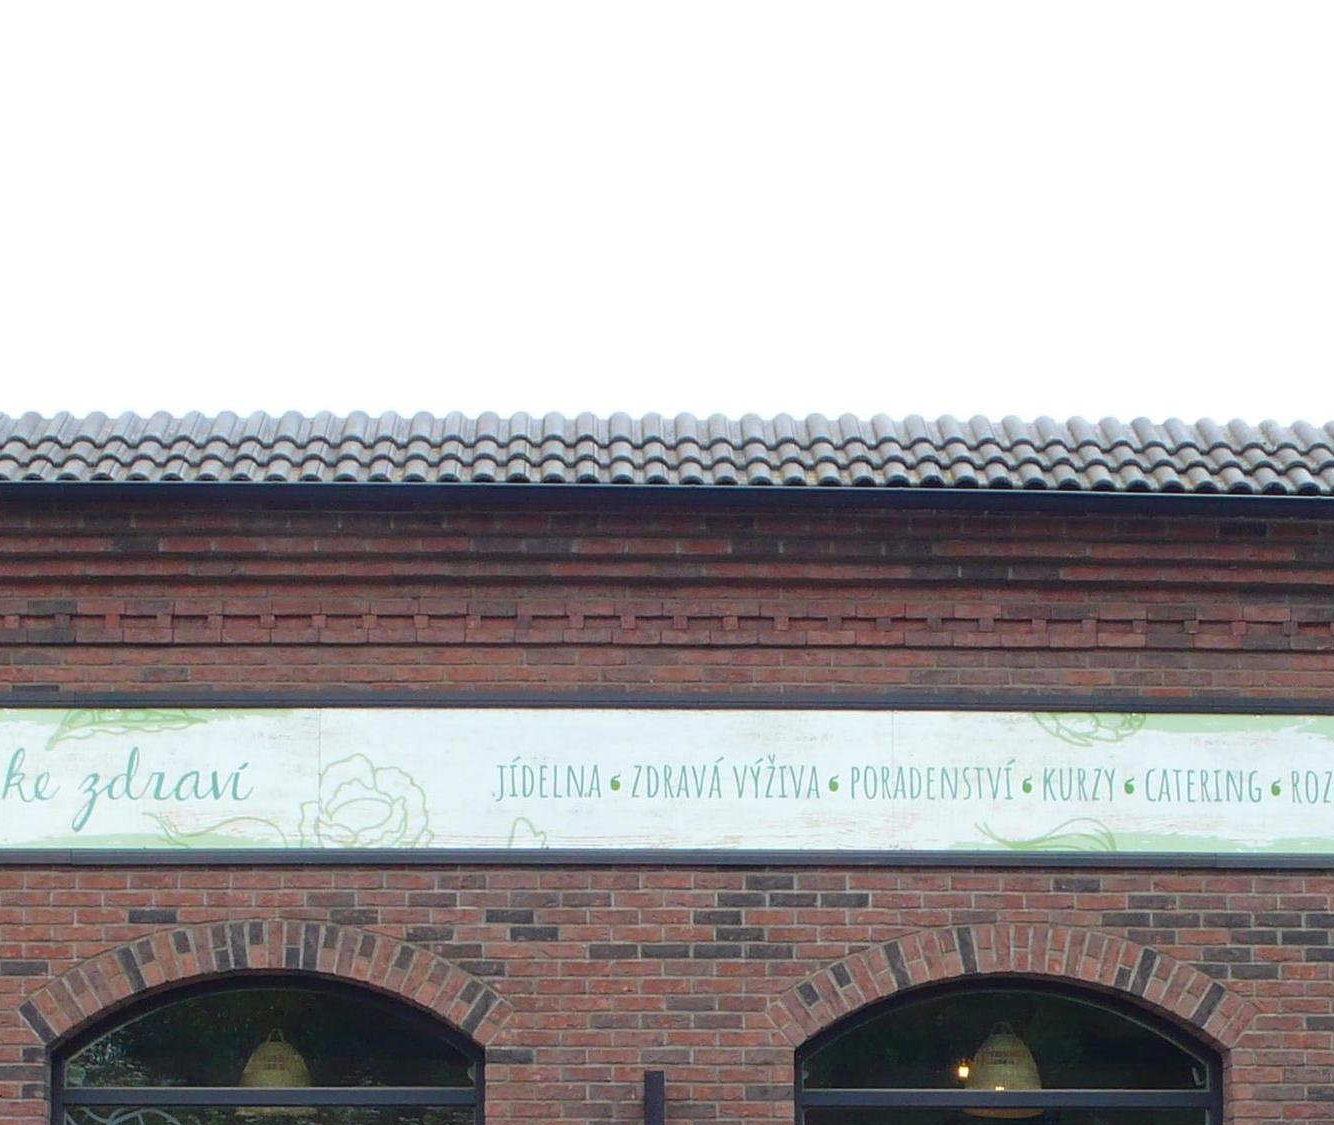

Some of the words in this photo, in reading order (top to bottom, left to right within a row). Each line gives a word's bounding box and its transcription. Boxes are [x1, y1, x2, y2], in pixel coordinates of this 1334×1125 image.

[2, 746, 61, 803] ke
[71, 746, 254, 833] zdraví
[496, 756, 602, 802] JÍDELNA
[631, 756, 725, 799] ZDRAVÁ
[732, 754, 820, 799] VÝŽIVA
[850, 758, 1016, 801] PORADENSTVÍ
[1042, 766, 1116, 802] KURZY
[1144, 767, 1263, 804] CATERING
